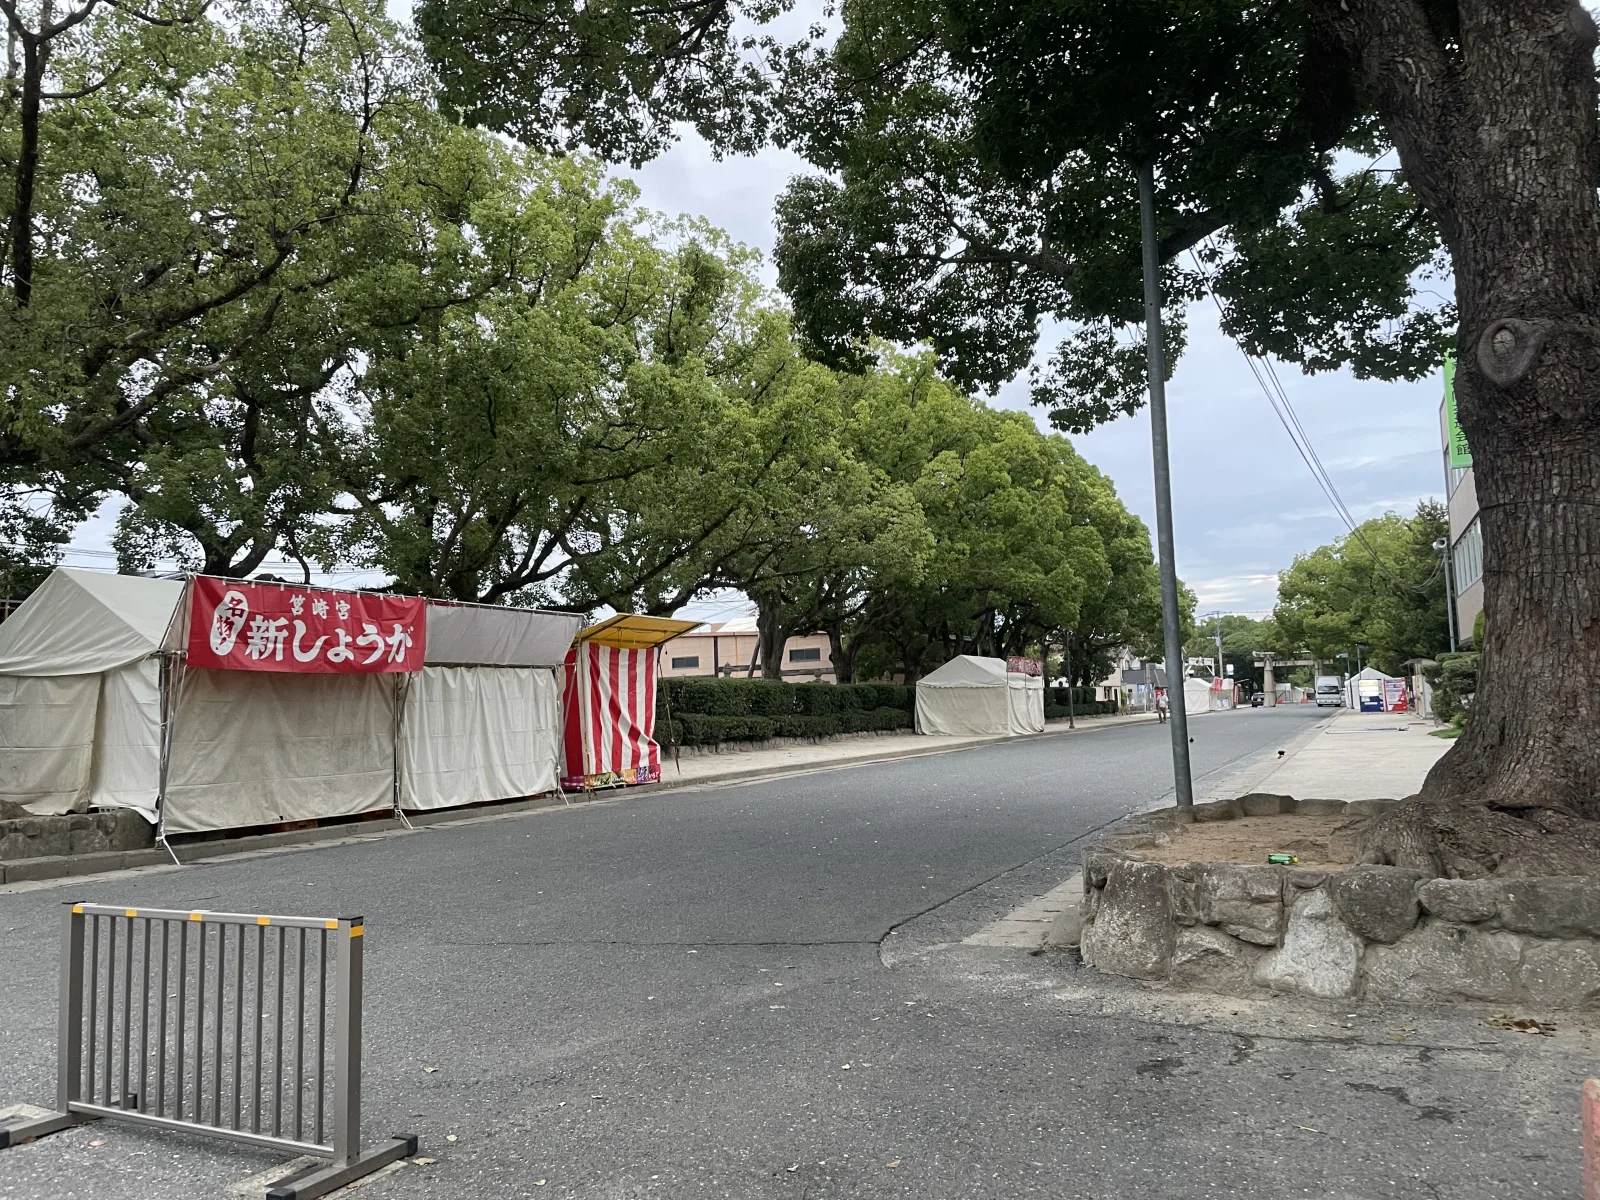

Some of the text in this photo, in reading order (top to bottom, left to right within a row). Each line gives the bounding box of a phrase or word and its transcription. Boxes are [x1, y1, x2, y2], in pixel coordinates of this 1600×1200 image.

[245, 614, 414, 665] 新しょうが
